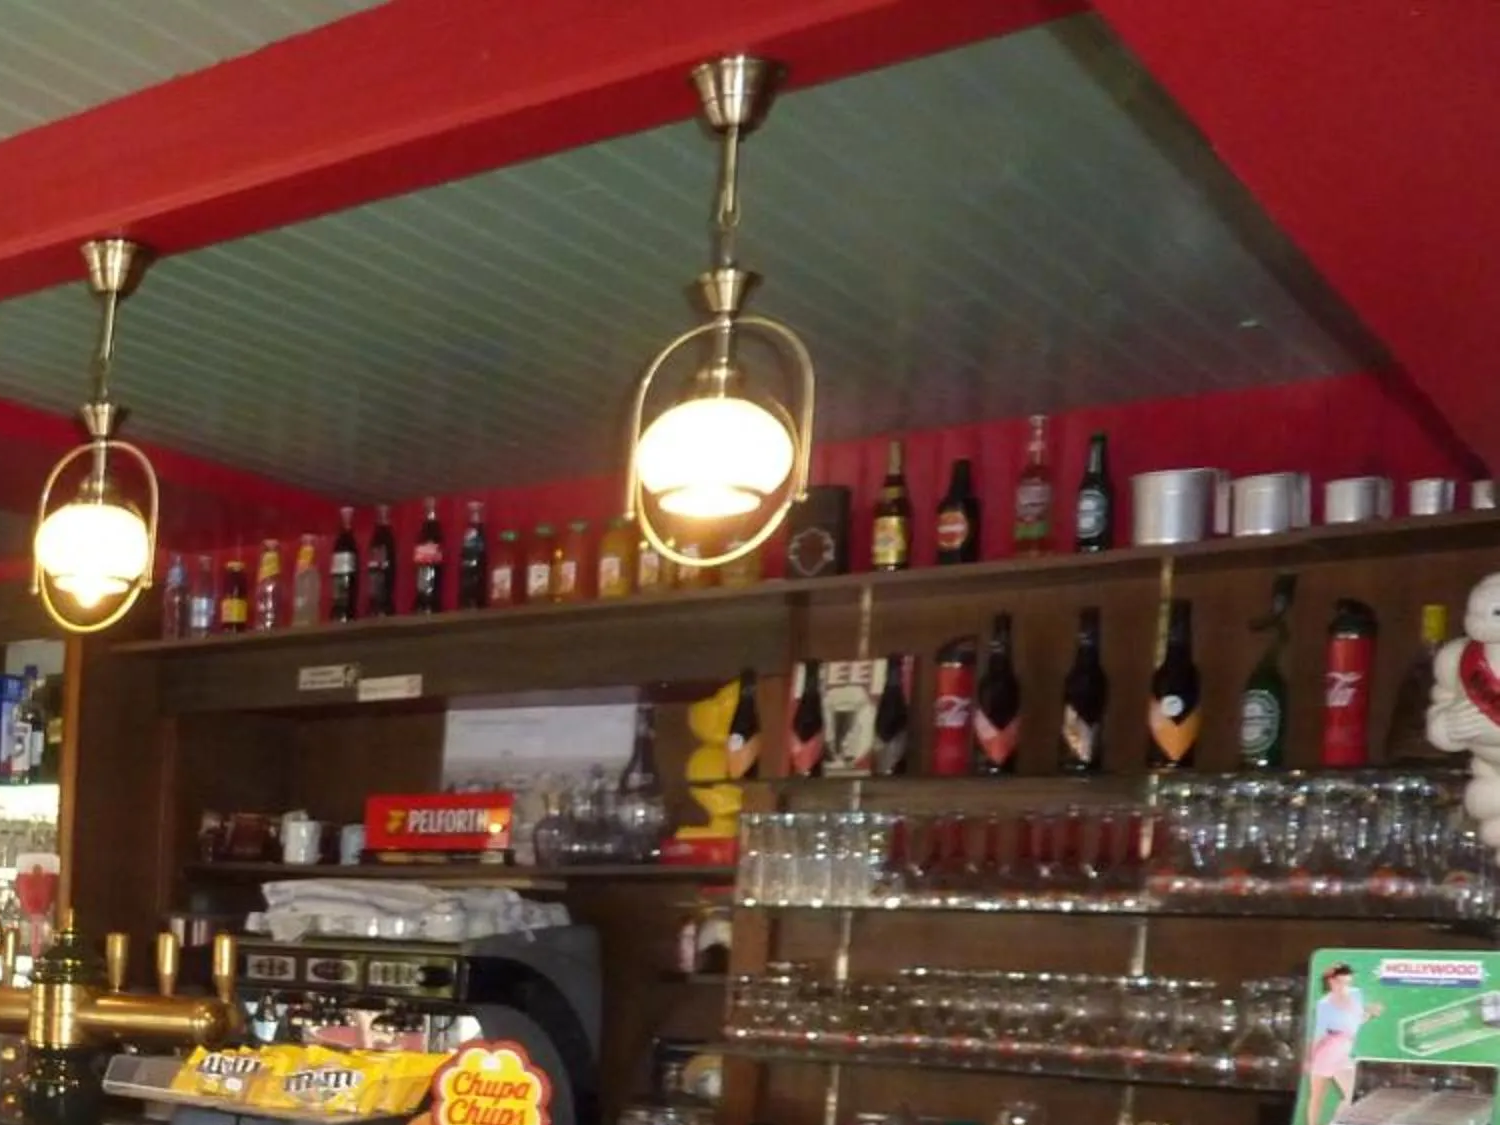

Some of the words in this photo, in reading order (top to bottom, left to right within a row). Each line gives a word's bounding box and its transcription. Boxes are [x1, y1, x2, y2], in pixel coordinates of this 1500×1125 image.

[408, 808, 488, 833] PELFORTH
[1385, 963, 1479, 975] HOLLYWOOD
[452, 1070, 531, 1107] Chupa
